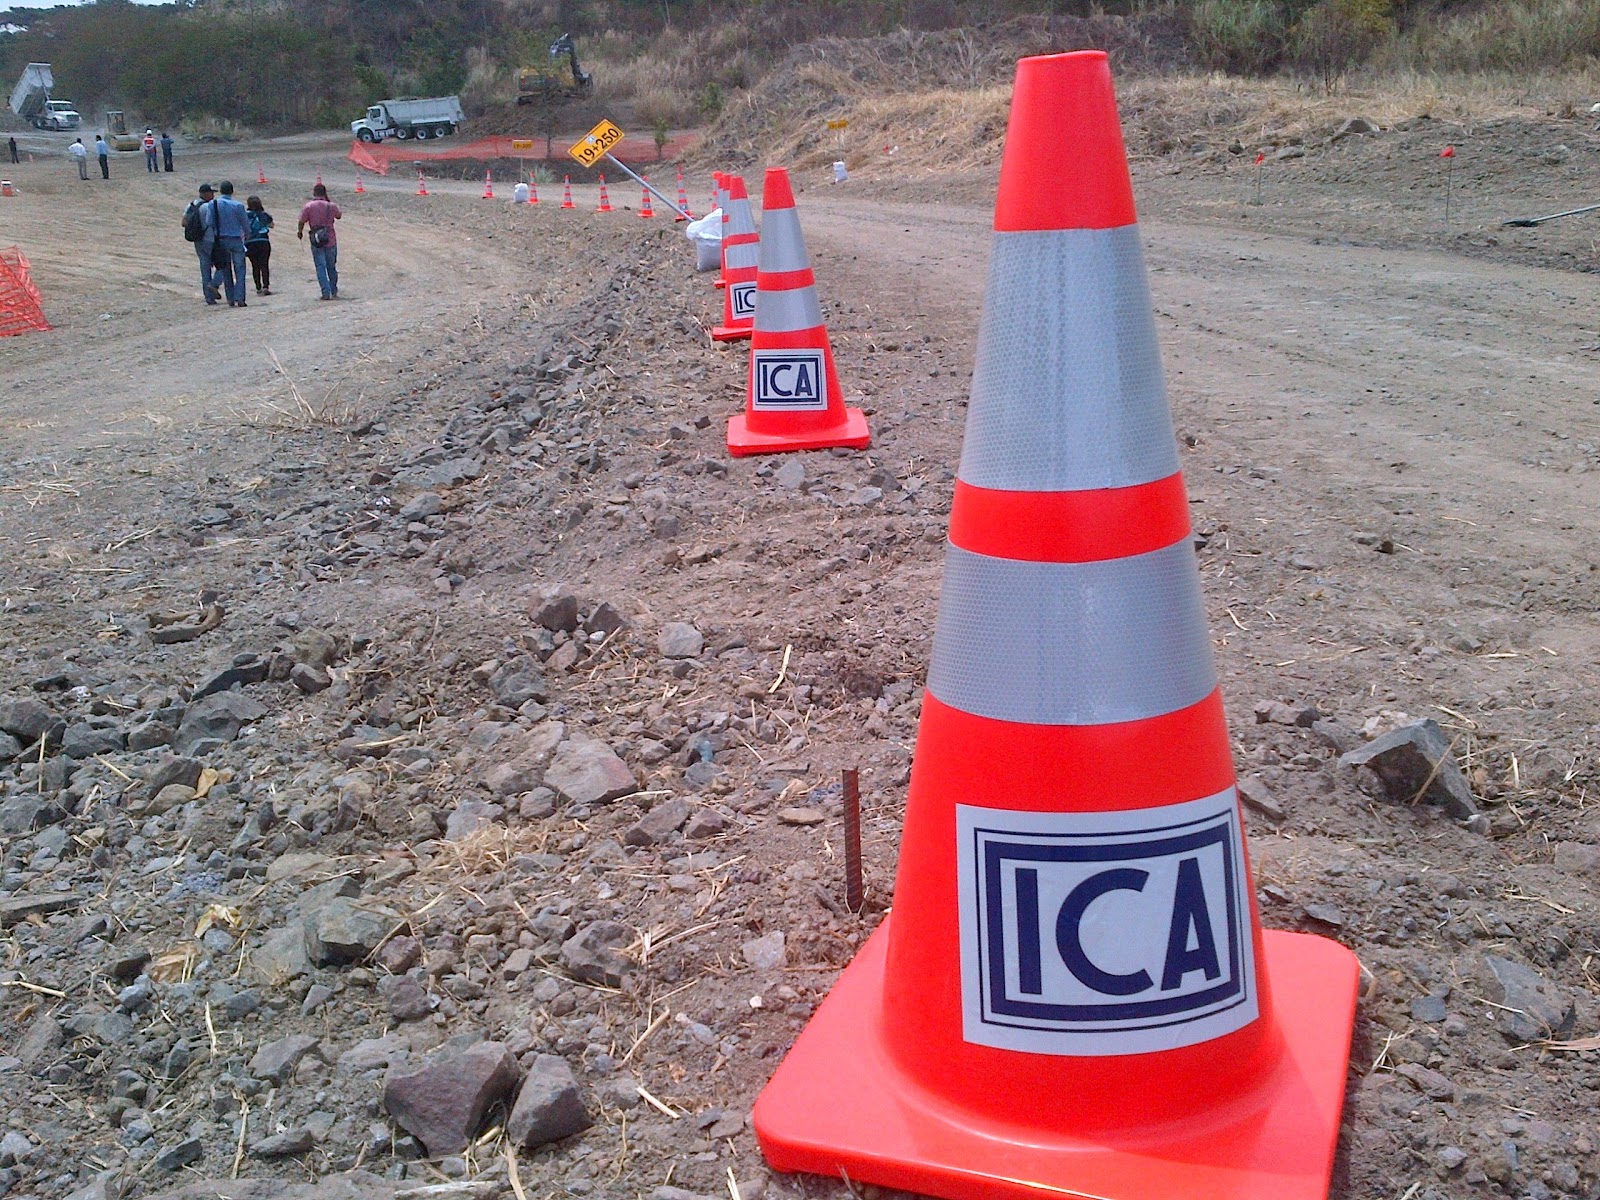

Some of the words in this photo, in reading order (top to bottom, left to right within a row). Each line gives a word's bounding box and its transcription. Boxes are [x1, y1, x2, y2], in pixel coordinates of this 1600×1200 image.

[577, 128, 619, 163] 19+250
[738, 289, 756, 310] IC
[763, 364, 813, 396] ICA
[1015, 857, 1221, 995] ICA
